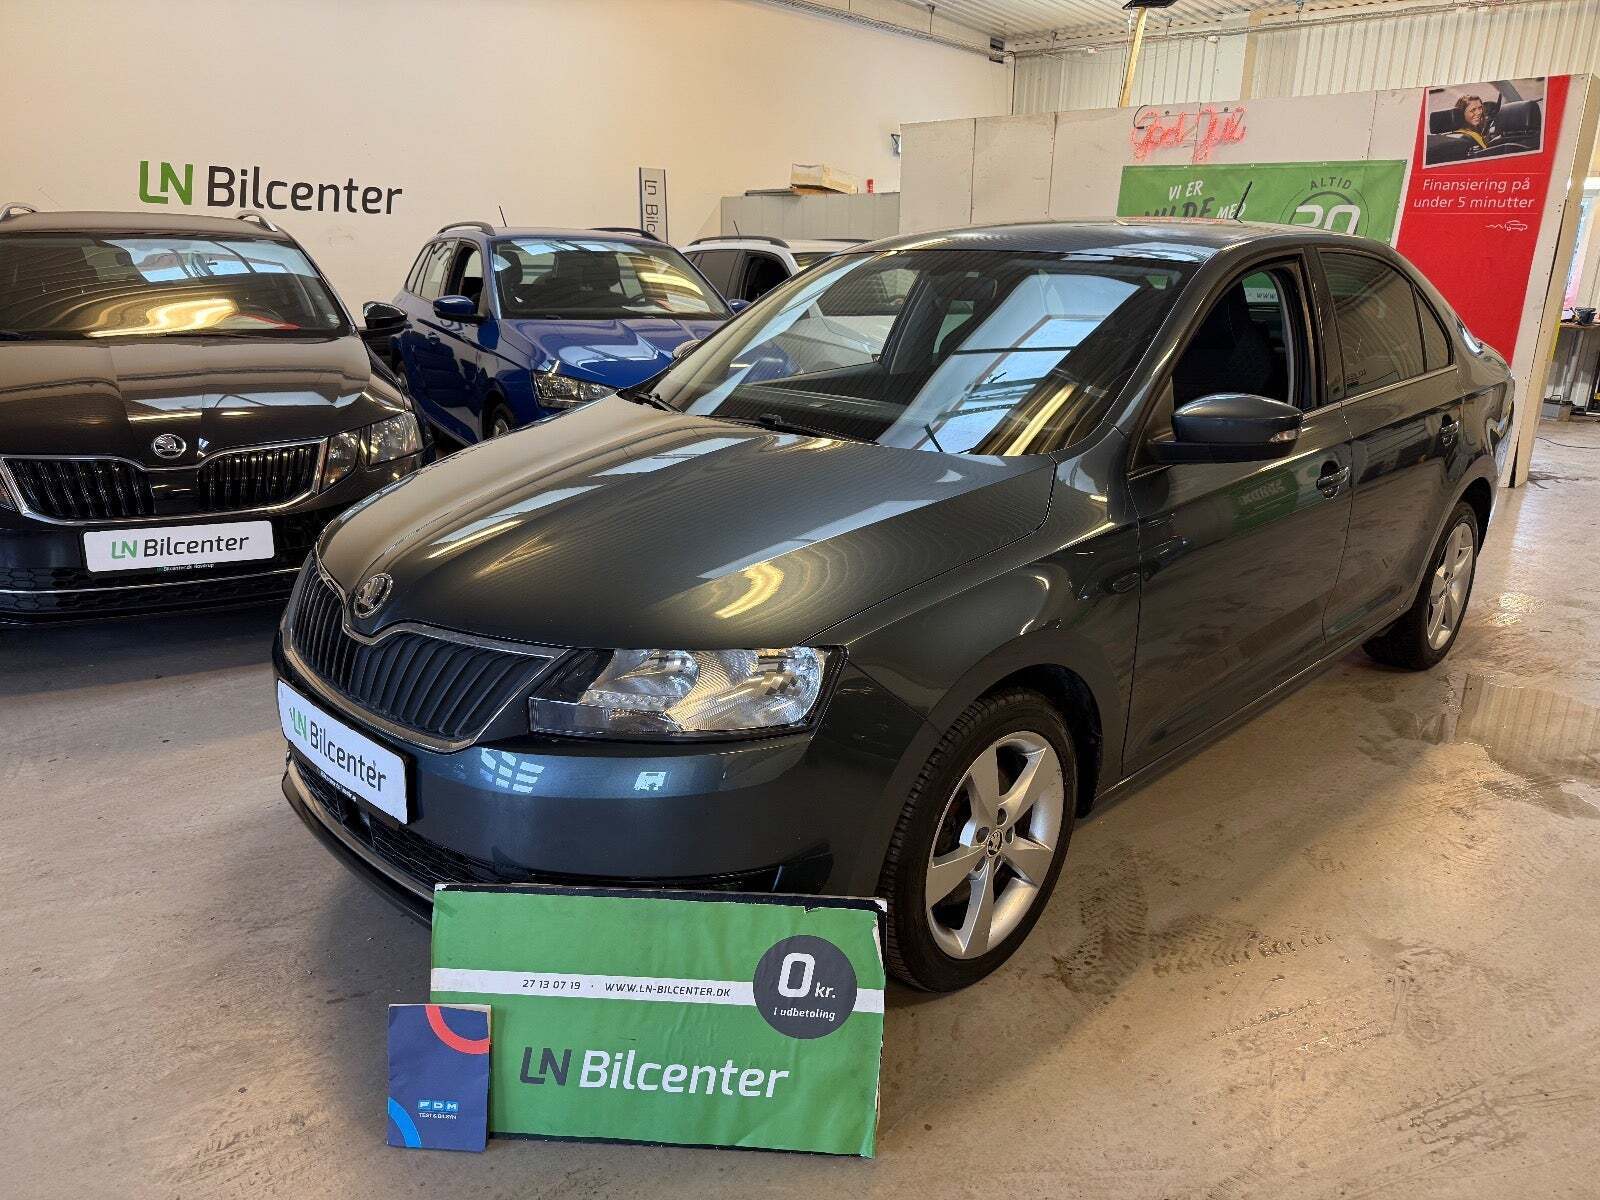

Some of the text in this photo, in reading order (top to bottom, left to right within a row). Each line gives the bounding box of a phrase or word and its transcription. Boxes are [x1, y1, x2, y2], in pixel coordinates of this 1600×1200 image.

[139, 160, 403, 214] LN Bilcenter
[1168, 180, 1204, 202] VI ER
[1310, 176, 1352, 190] ALTID
[1422, 177, 1531, 193] Finansiering på
[1413, 196, 1535, 208] under 5 minutter
[111, 535, 250, 560] LN Bilcenter
[292, 706, 308, 741] LN
[310, 720, 387, 792] Bilcenter
[777, 952, 836, 999] 0 kr.
[522, 979, 731, 997] 27 13 07 19 WWW.LN-BILCENTER.DK
[780, 1007, 836, 1022] udbetaling
[519, 1046, 790, 1098] LN Bilcenter
[419, 1101, 458, 1110] FDM
